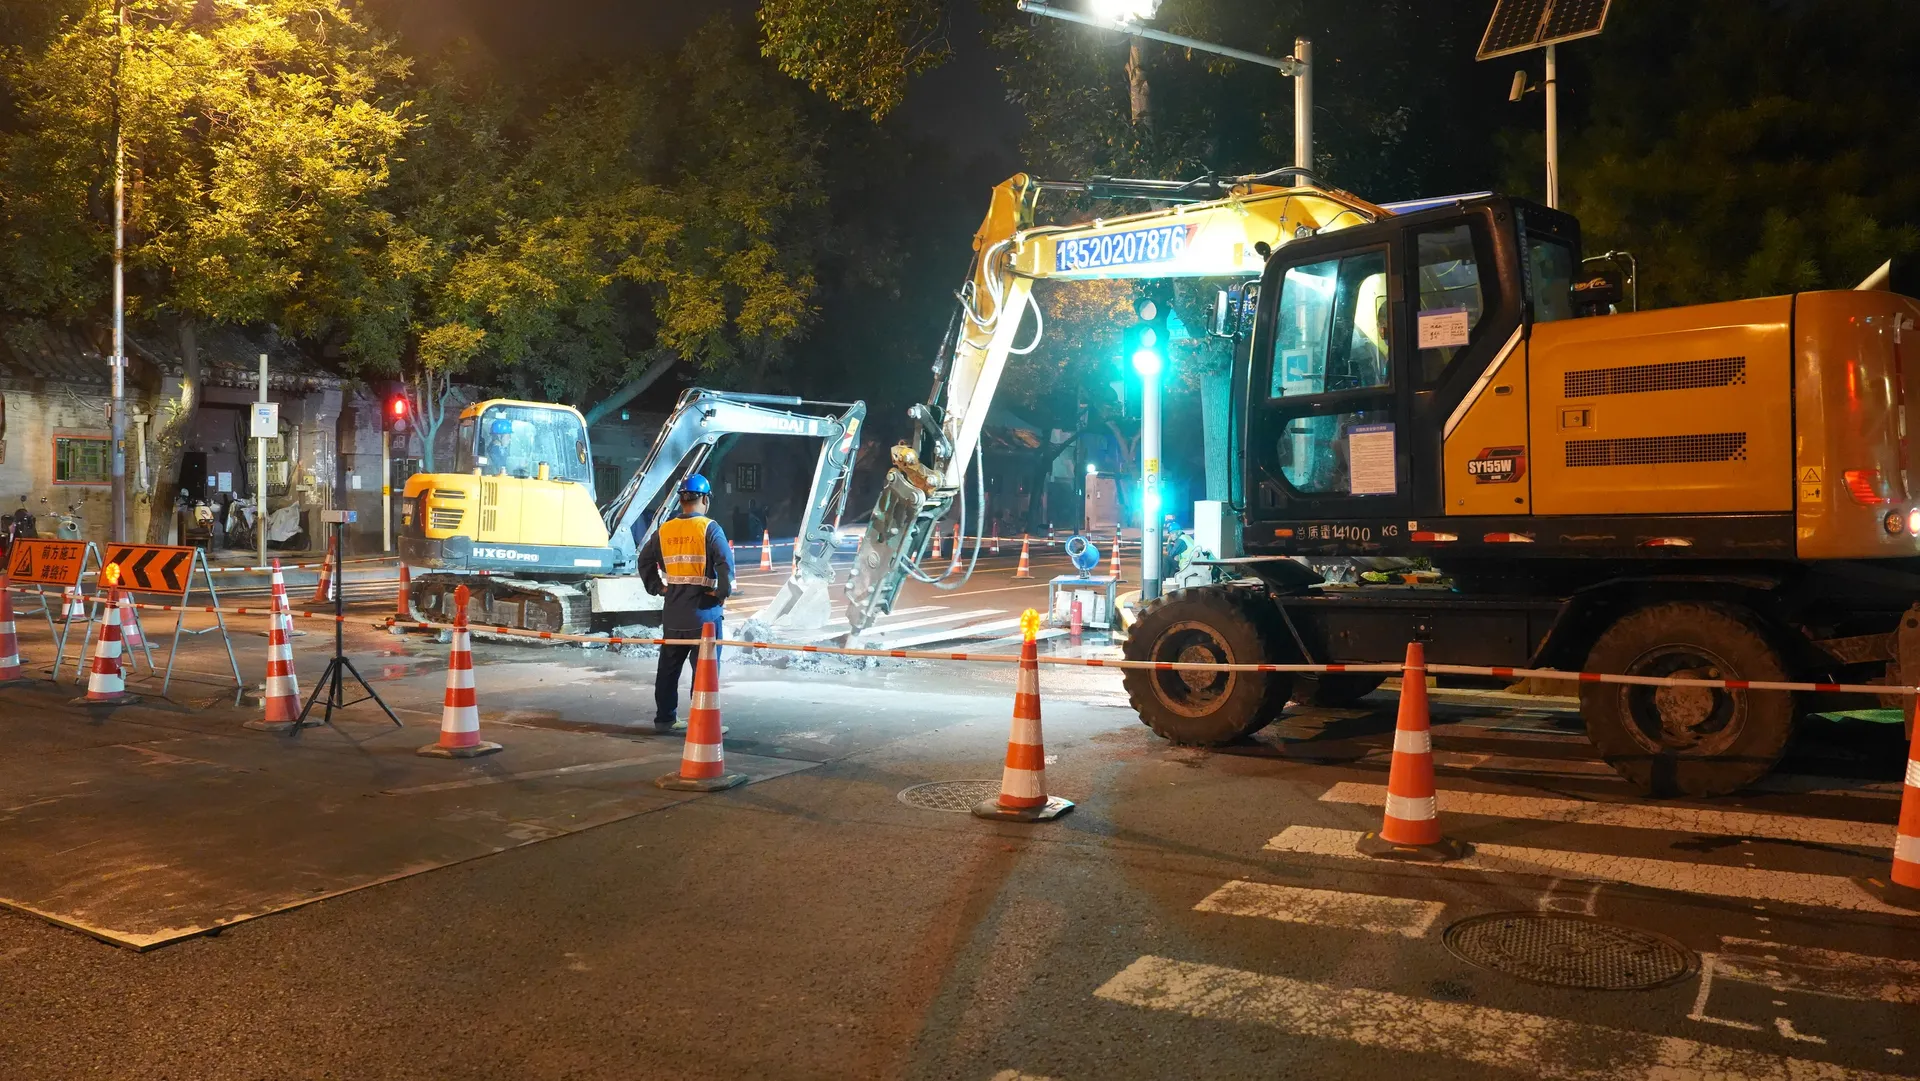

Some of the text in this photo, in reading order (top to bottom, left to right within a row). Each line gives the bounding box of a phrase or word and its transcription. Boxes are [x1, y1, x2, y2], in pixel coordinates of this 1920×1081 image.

[1057, 226, 1184, 270] 13520207876
[1469, 460, 1511, 474] SY155W
[1382, 525, 1398, 536] KG
[42, 545, 78, 560] 前方施工
[473, 547, 539, 562] HX60PRO
